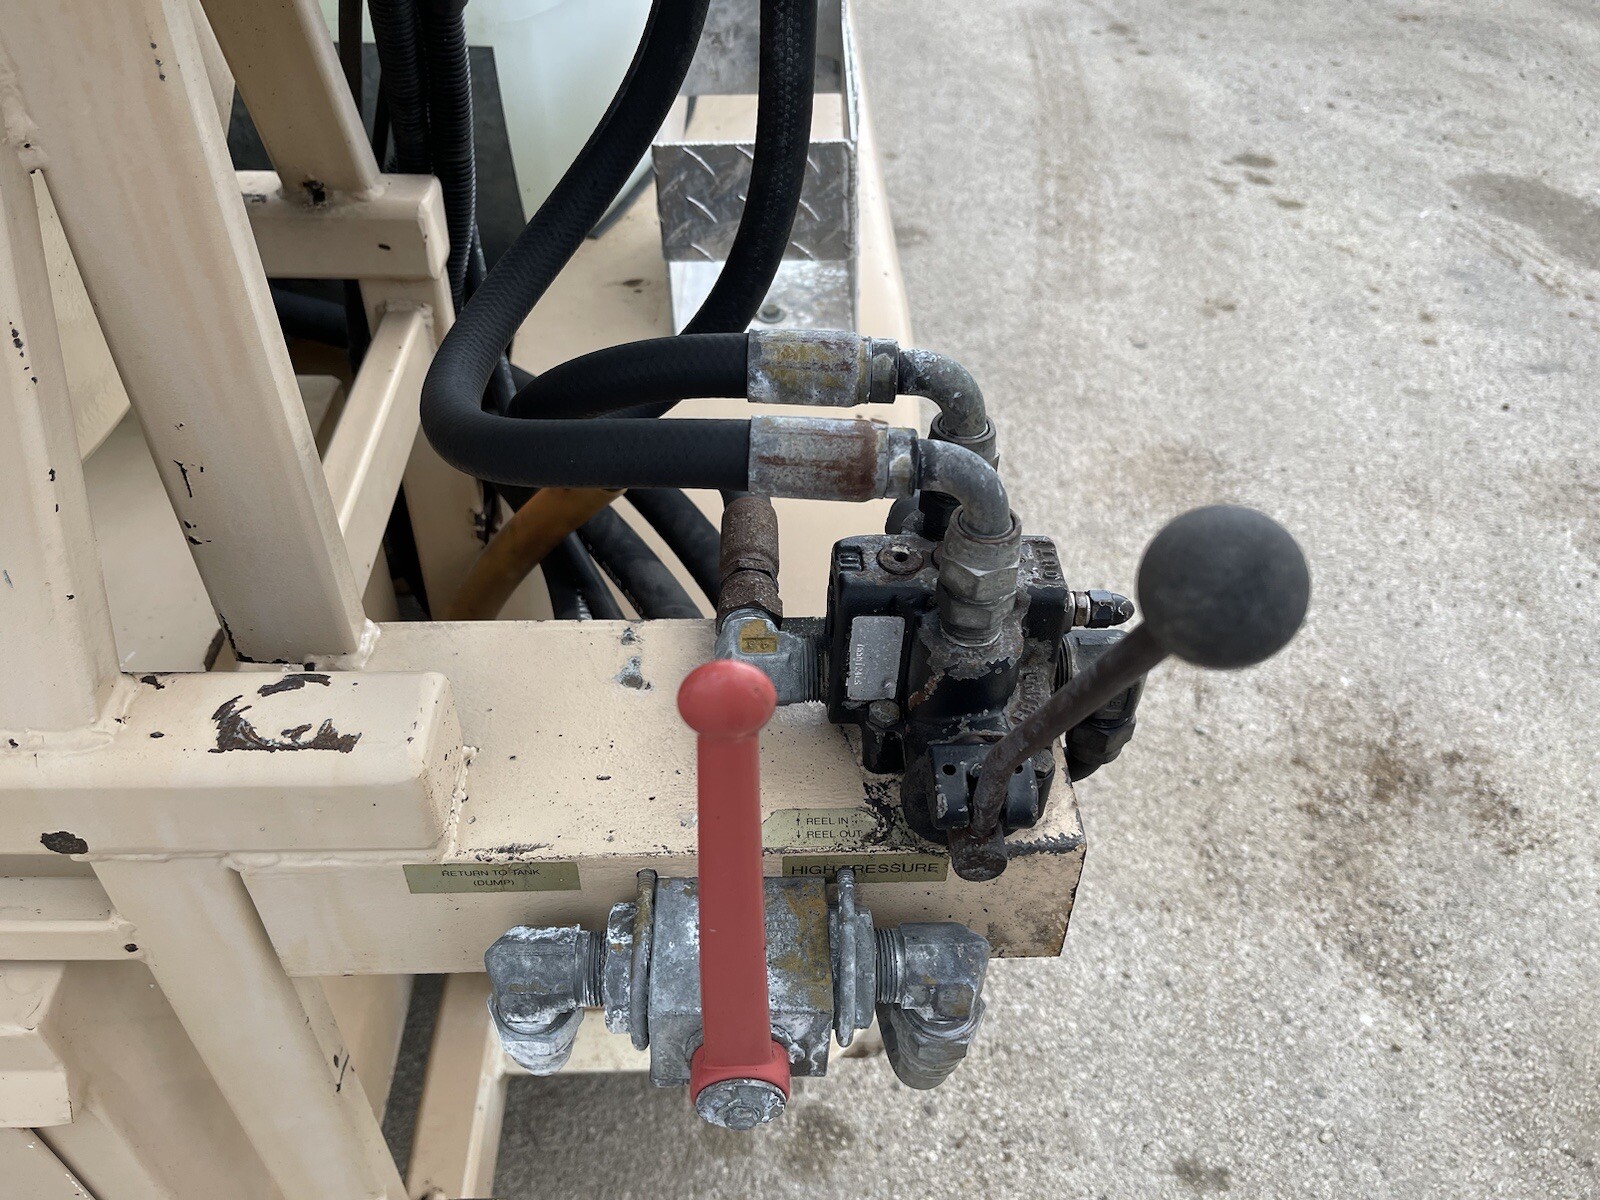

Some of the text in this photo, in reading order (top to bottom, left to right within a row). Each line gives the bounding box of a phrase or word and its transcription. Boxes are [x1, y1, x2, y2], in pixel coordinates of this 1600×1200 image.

[806, 817, 849, 825] REEL IN
[806, 830, 862, 839] REEL OUT
[441, 868, 541, 877] RETURN TO TANK
[791, 862, 940, 875] HIGH RESSURE
[473, 879, 515, 887] (DUMP)
